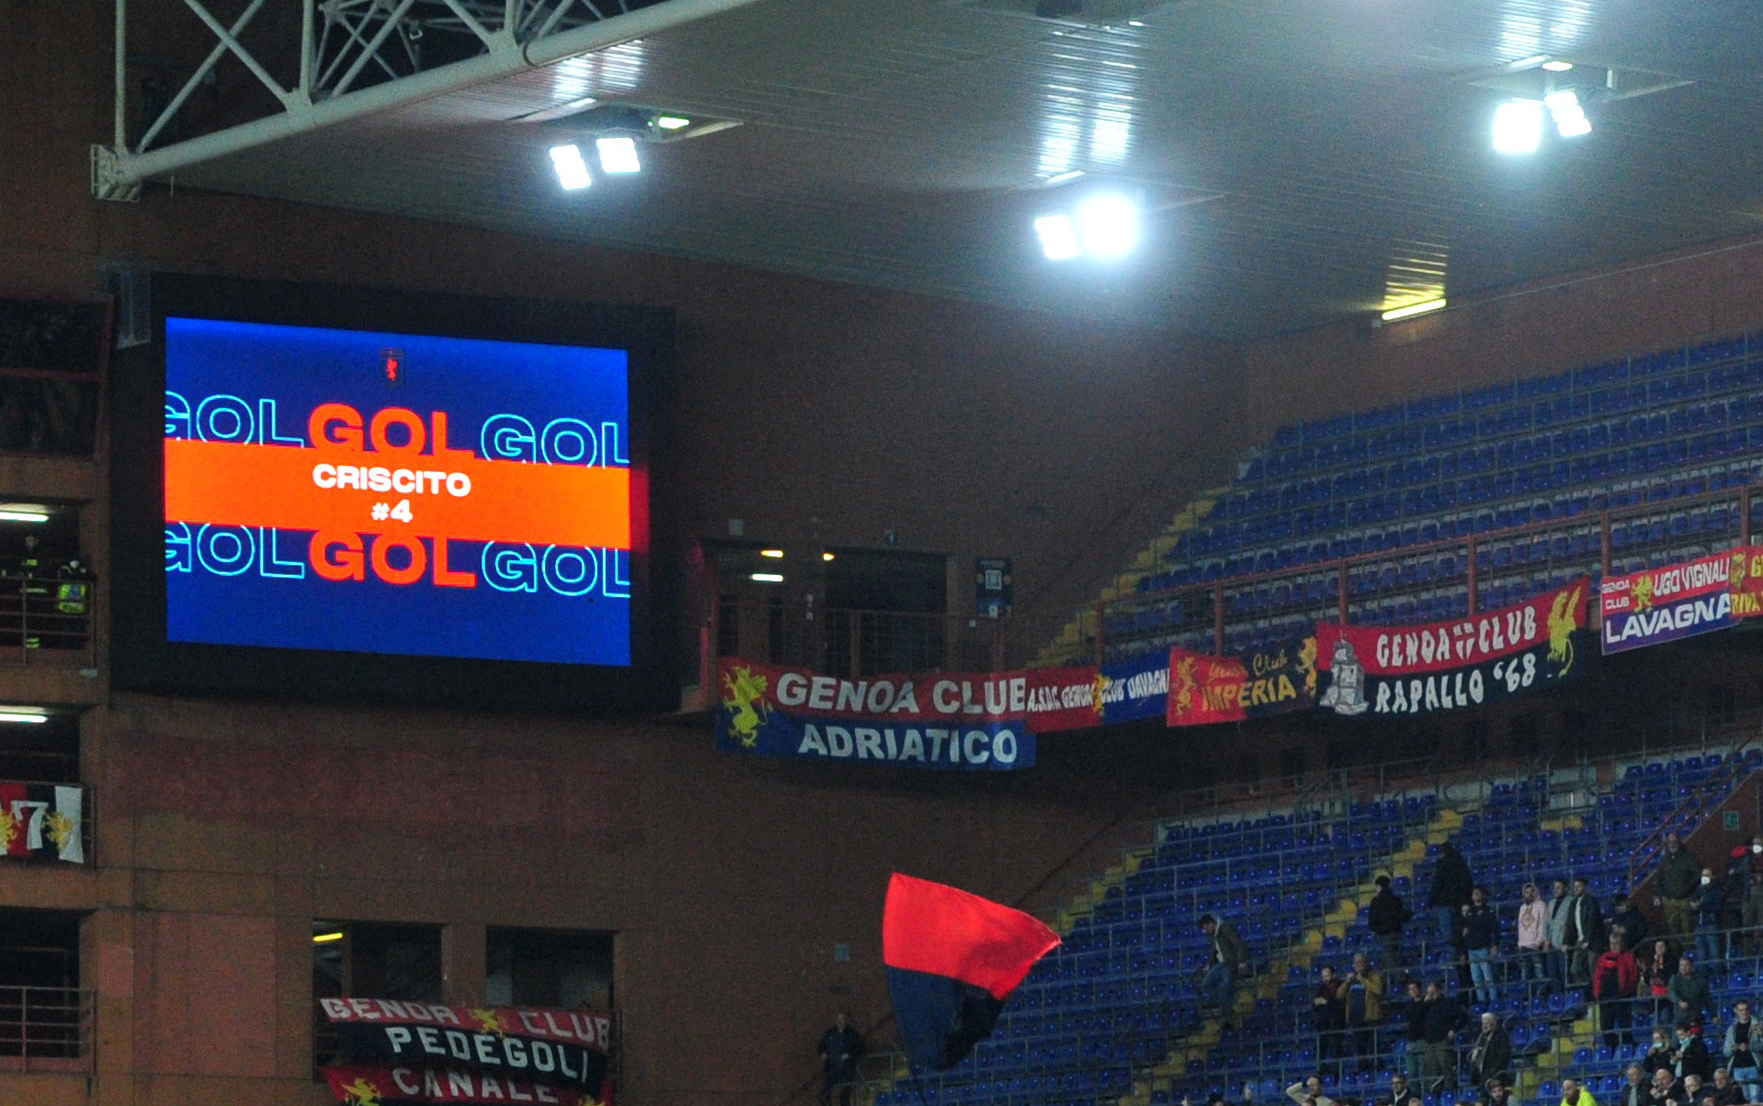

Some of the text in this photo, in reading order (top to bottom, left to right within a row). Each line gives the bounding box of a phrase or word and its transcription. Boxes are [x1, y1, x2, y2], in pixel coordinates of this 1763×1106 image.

[308, 403, 475, 461] GOL
[481, 414, 630, 470] GOL
[312, 463, 472, 498] CRISCITO
[371, 499, 414, 523] #4
[308, 530, 476, 588] GOL
[481, 540, 630, 598] GOL
[1653, 557, 1730, 597] UGO VIGNALI
[1377, 605, 1536, 668] GENOA CLUB
[1605, 593, 1731, 644] LAVAGNA
[776, 672, 920, 714] GENOA
[1201, 674, 1297, 712] IMPERIA
[1374, 668, 1484, 714] RAPALLO
[798, 725, 1017, 764] ADRIATICO
[320, 997, 611, 1051] GENOA CLUB
[391, 1066, 559, 1104] CANALE
